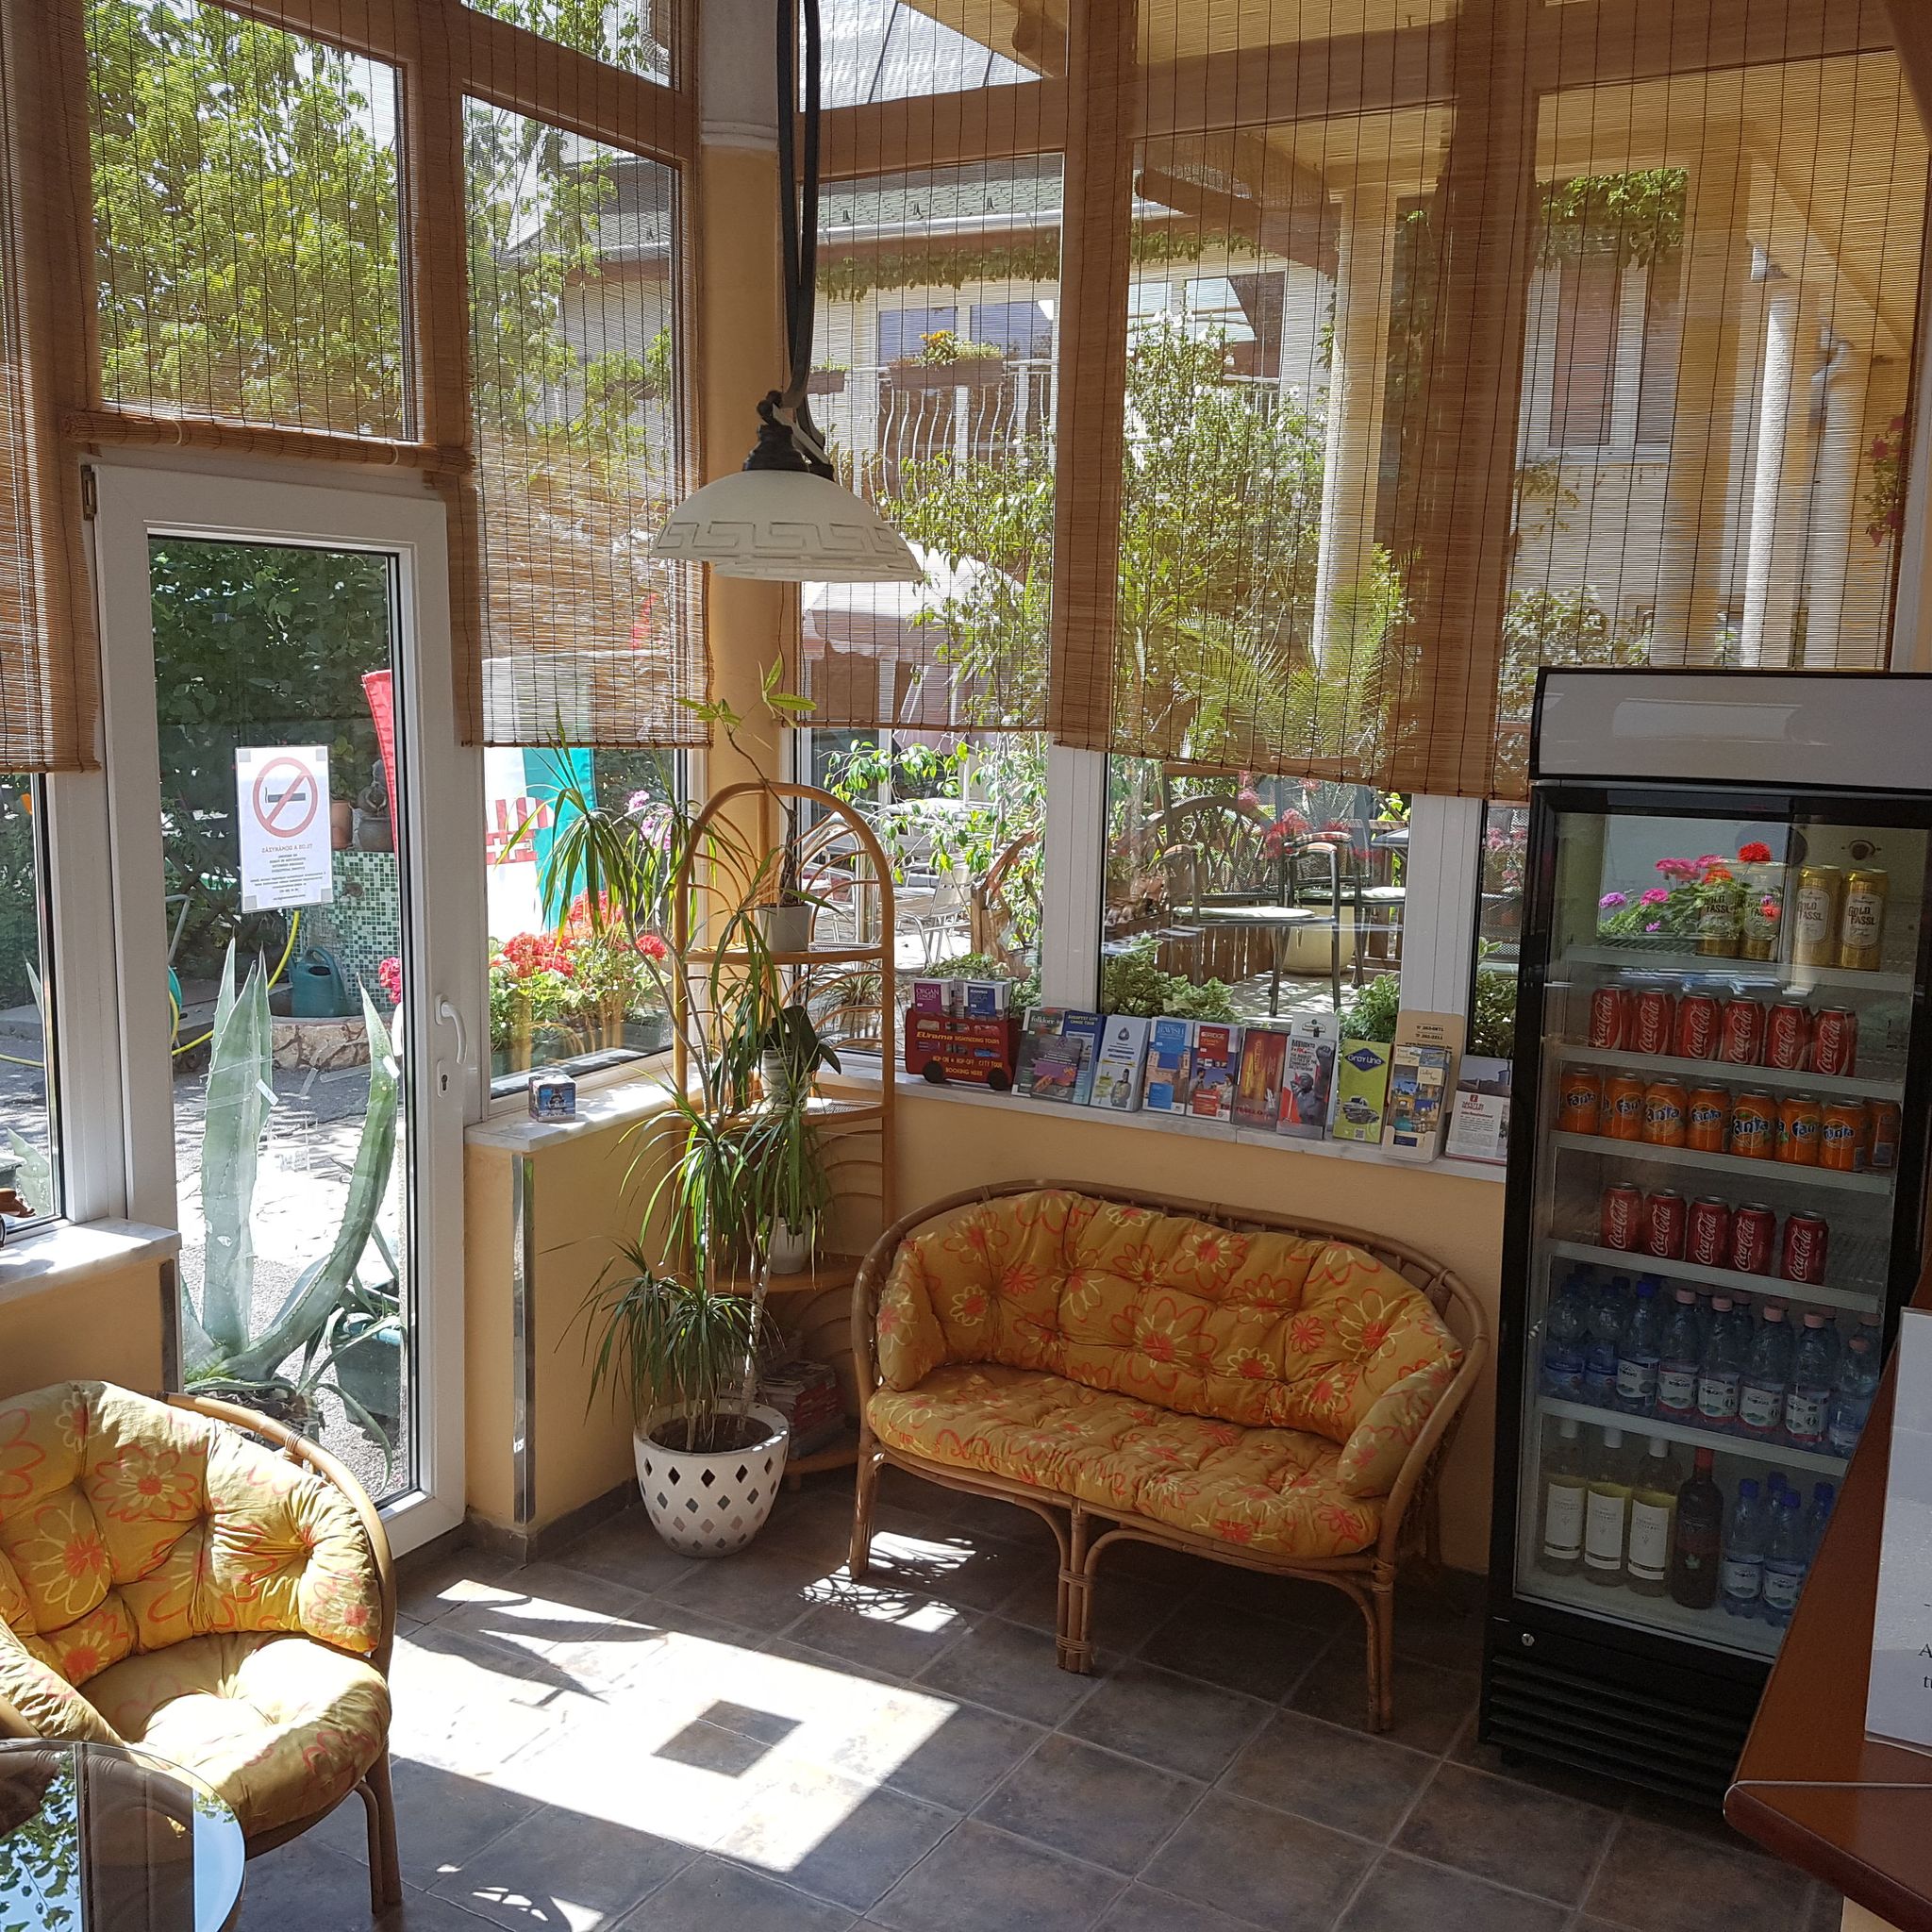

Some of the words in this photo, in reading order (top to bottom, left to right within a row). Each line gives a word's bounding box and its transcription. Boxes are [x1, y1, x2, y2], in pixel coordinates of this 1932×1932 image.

[1848, 906, 1872, 918] GOLD
[1347, 1055, 1367, 1063] Gray
[1367, 1056, 1382, 1065] Line
[1566, 1091, 1596, 1108] Fanta
[1645, 1105, 1681, 1123] anta
[1690, 1107, 1722, 1124] Fanta
[1823, 1123, 1856, 1141] Fanta
